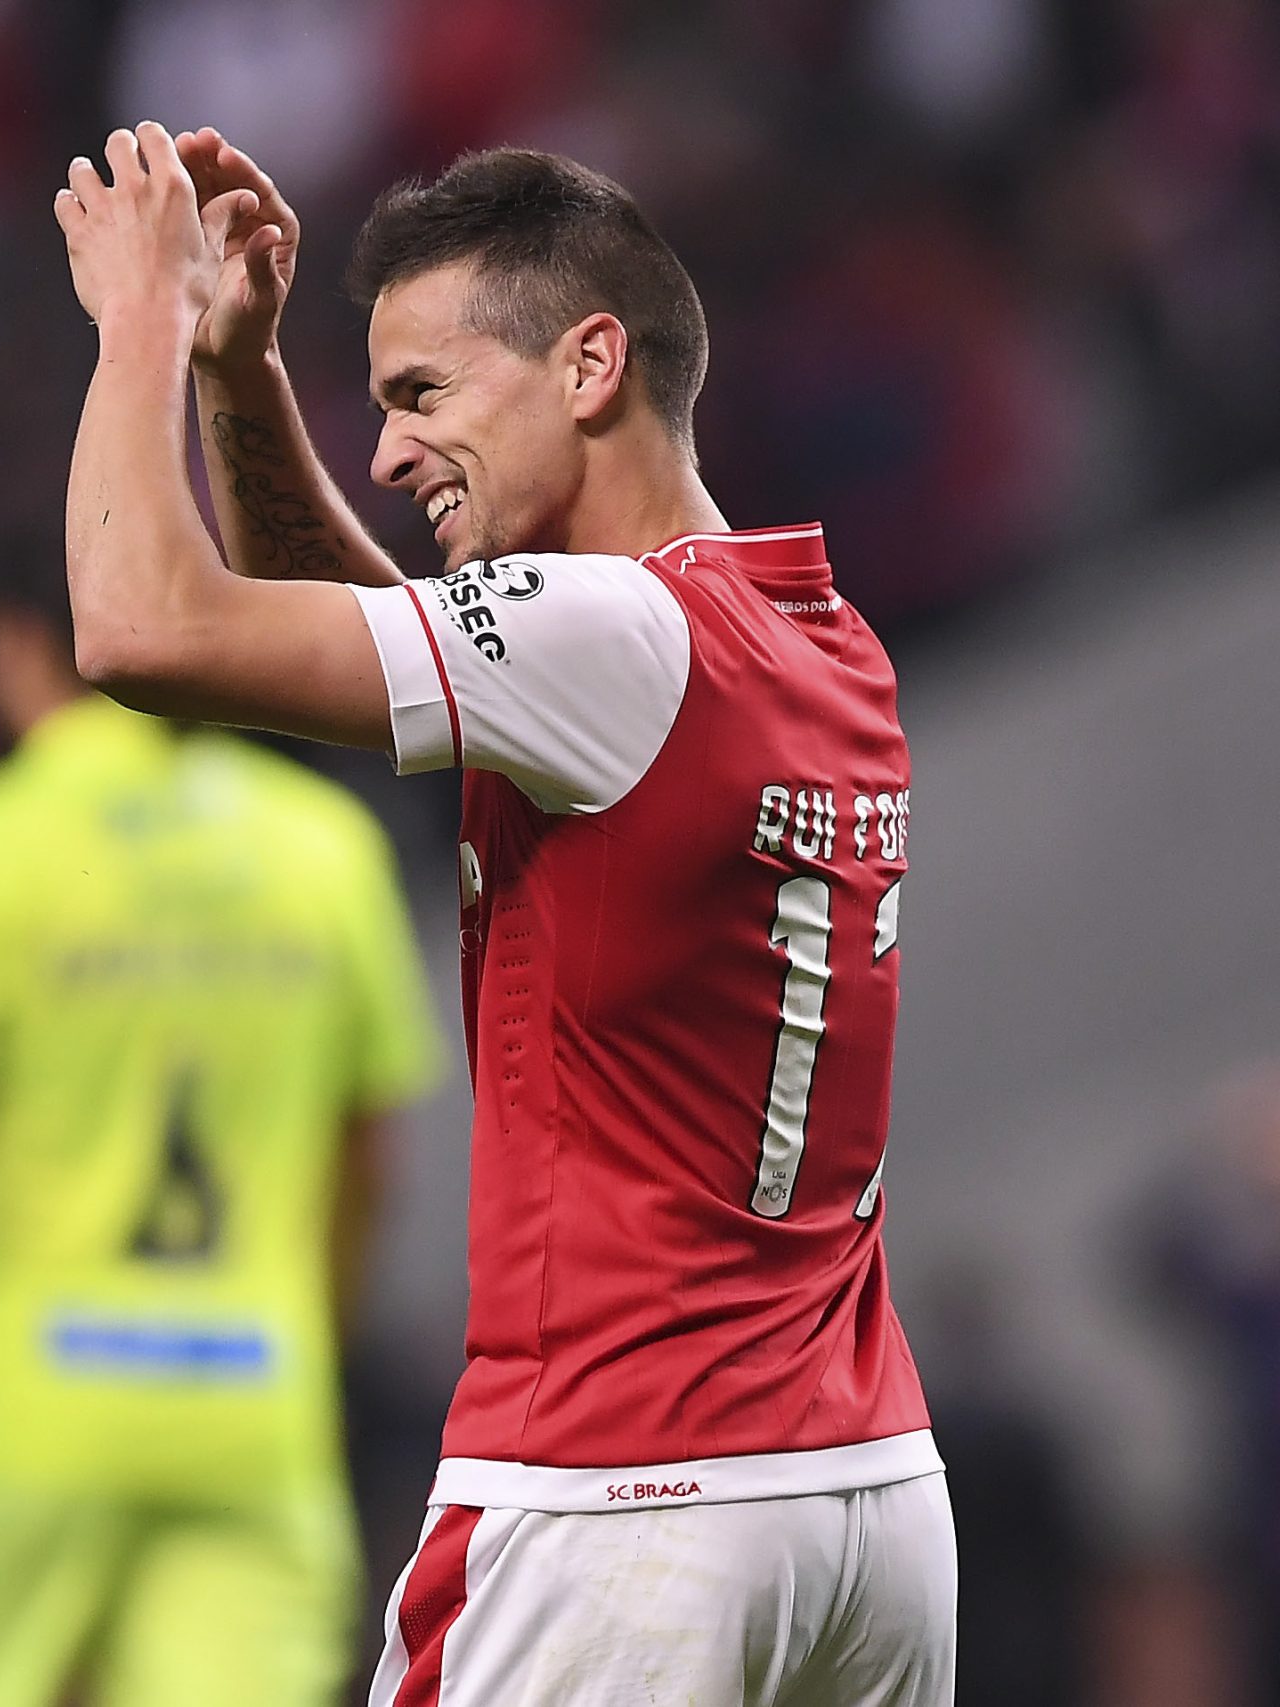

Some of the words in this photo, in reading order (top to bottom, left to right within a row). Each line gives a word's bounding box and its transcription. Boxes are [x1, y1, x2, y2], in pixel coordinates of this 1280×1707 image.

[753, 784, 837, 860] RUI
[607, 1484, 630, 1501] SC
[633, 1481, 702, 1500] BRAGA
